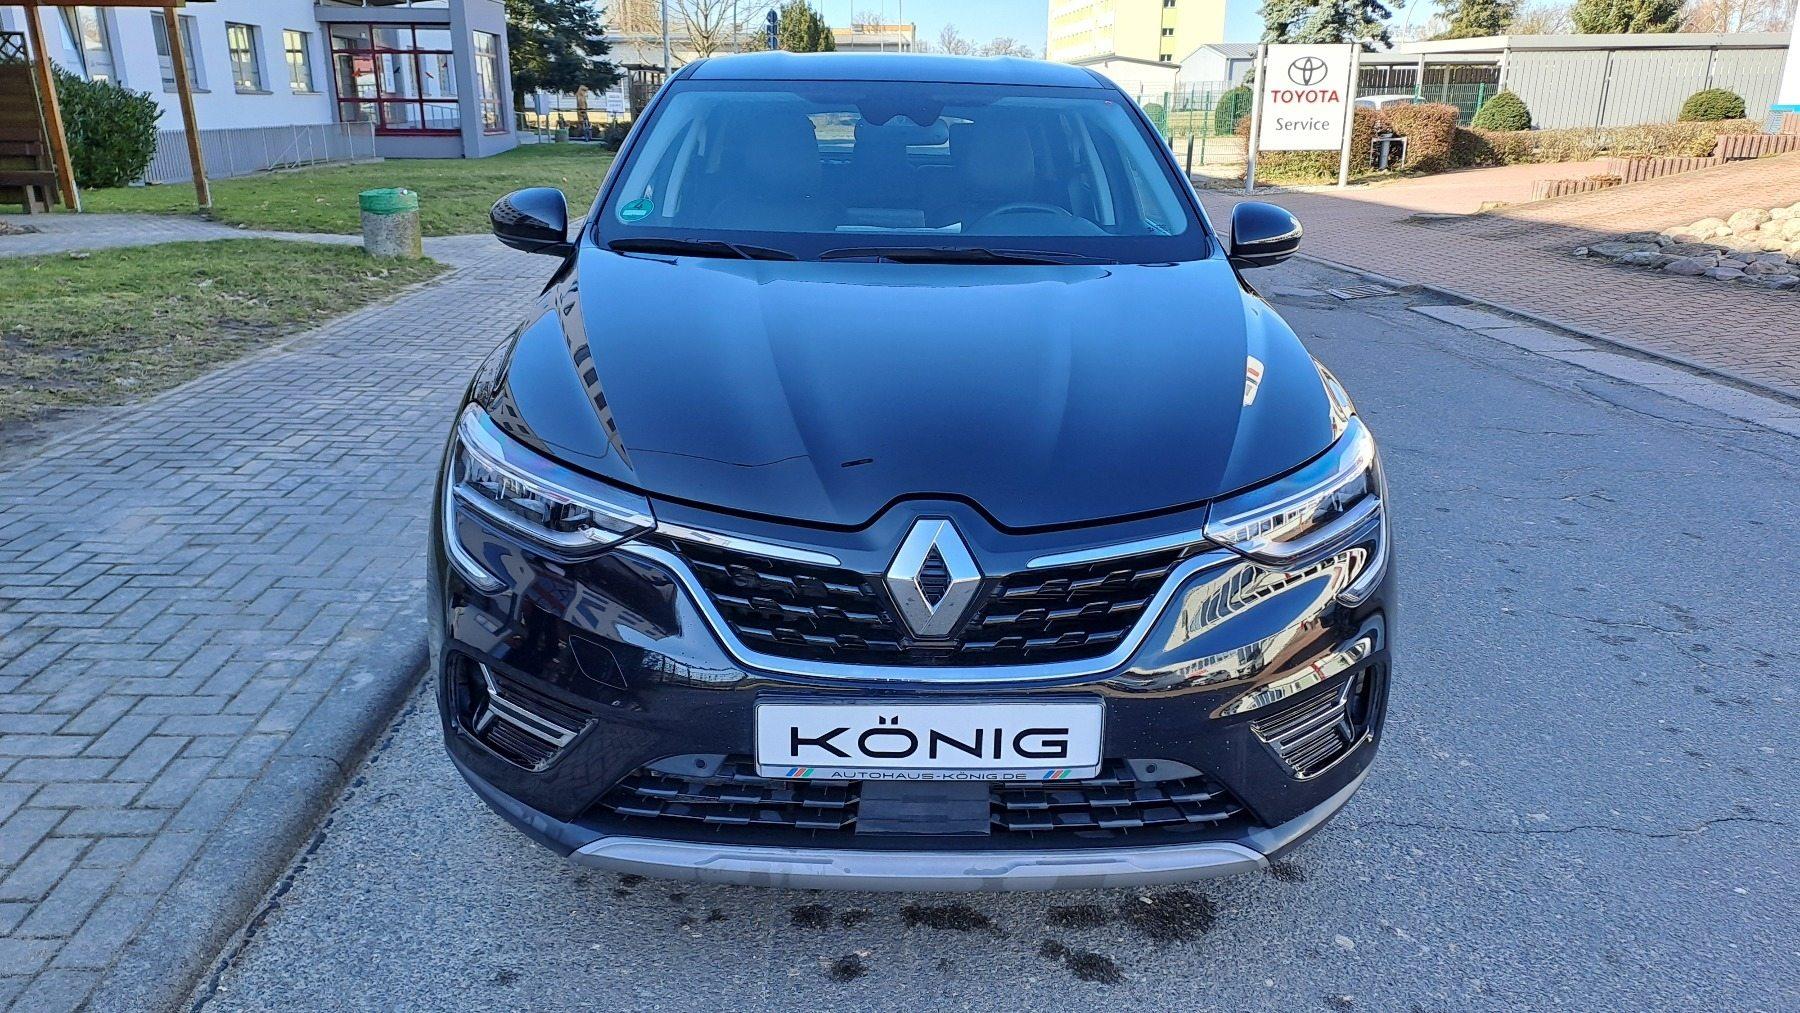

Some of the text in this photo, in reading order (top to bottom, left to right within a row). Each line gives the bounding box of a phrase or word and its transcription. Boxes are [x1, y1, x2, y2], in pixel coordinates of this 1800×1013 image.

[1271, 90, 1340, 103] TOYOTA
[1276, 117, 1330, 131] Service
[790, 715, 1069, 759] KÖNIG
[831, 771, 1027, 780] AUTOHAUS-KÖNIG.DE
